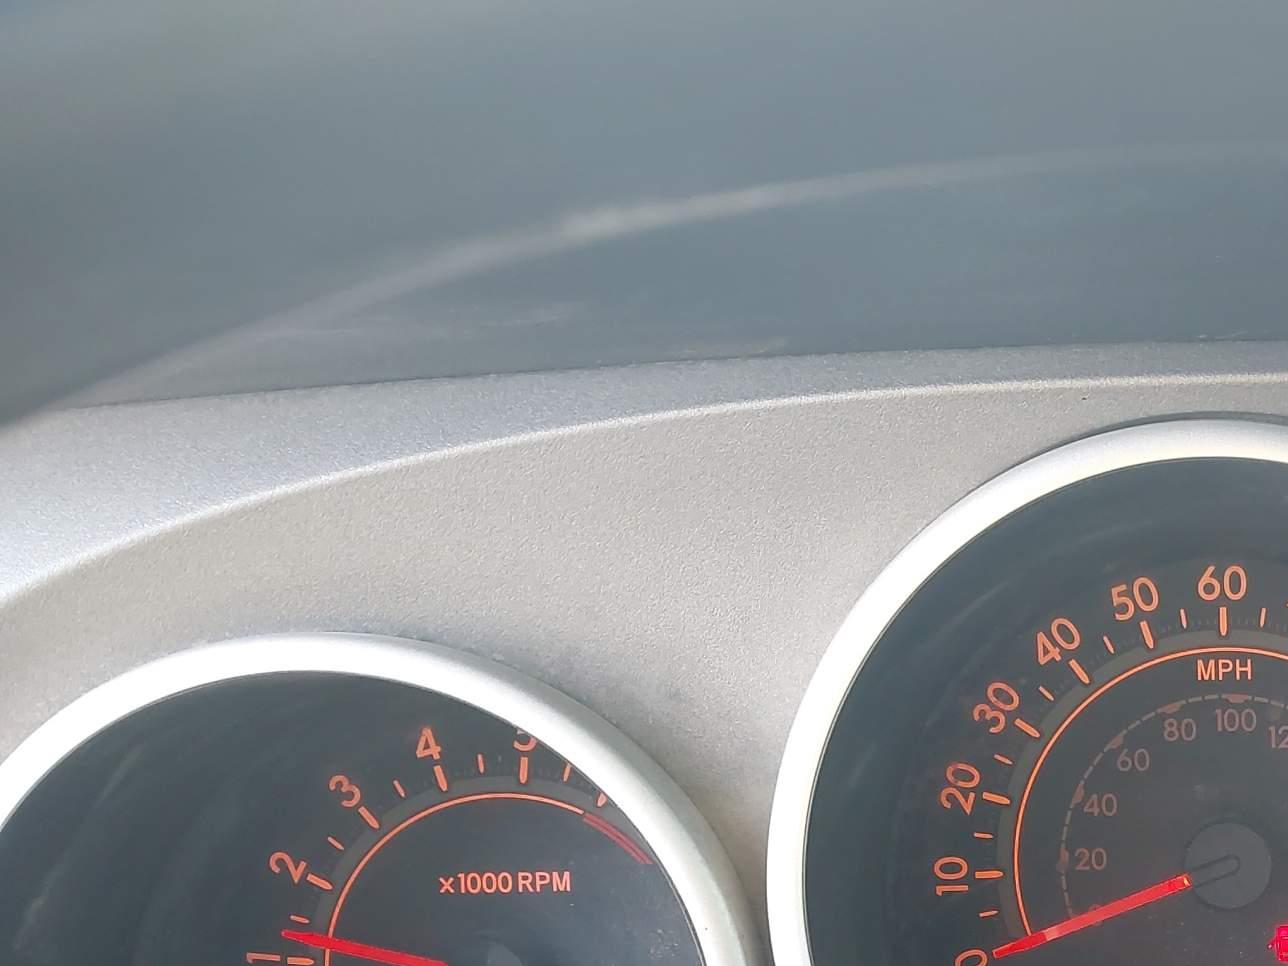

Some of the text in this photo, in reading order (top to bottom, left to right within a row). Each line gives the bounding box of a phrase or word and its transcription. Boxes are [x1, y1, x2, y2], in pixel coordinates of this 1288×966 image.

[1111, 577, 1159, 621] 50
[1197, 565, 1247, 601] 60
[1036, 617, 1081, 666] 40
[1196, 658, 1252, 681] MPH
[972, 682, 1020, 733] 30
[1215, 708, 1257, 732] 100
[416, 727, 441, 760] 4
[1163, 718, 1197, 742] 80
[1116, 749, 1150, 772] 60
[328, 774, 362, 808] 3
[940, 763, 980, 816] 20
[1083, 793, 1118, 817] 40
[269, 851, 307, 884] 2
[934, 856, 969, 896] 10
[1075, 848, 1107, 871] 20
[518, 871, 571, 892] RPM
[246, 951, 281, 966] 1
